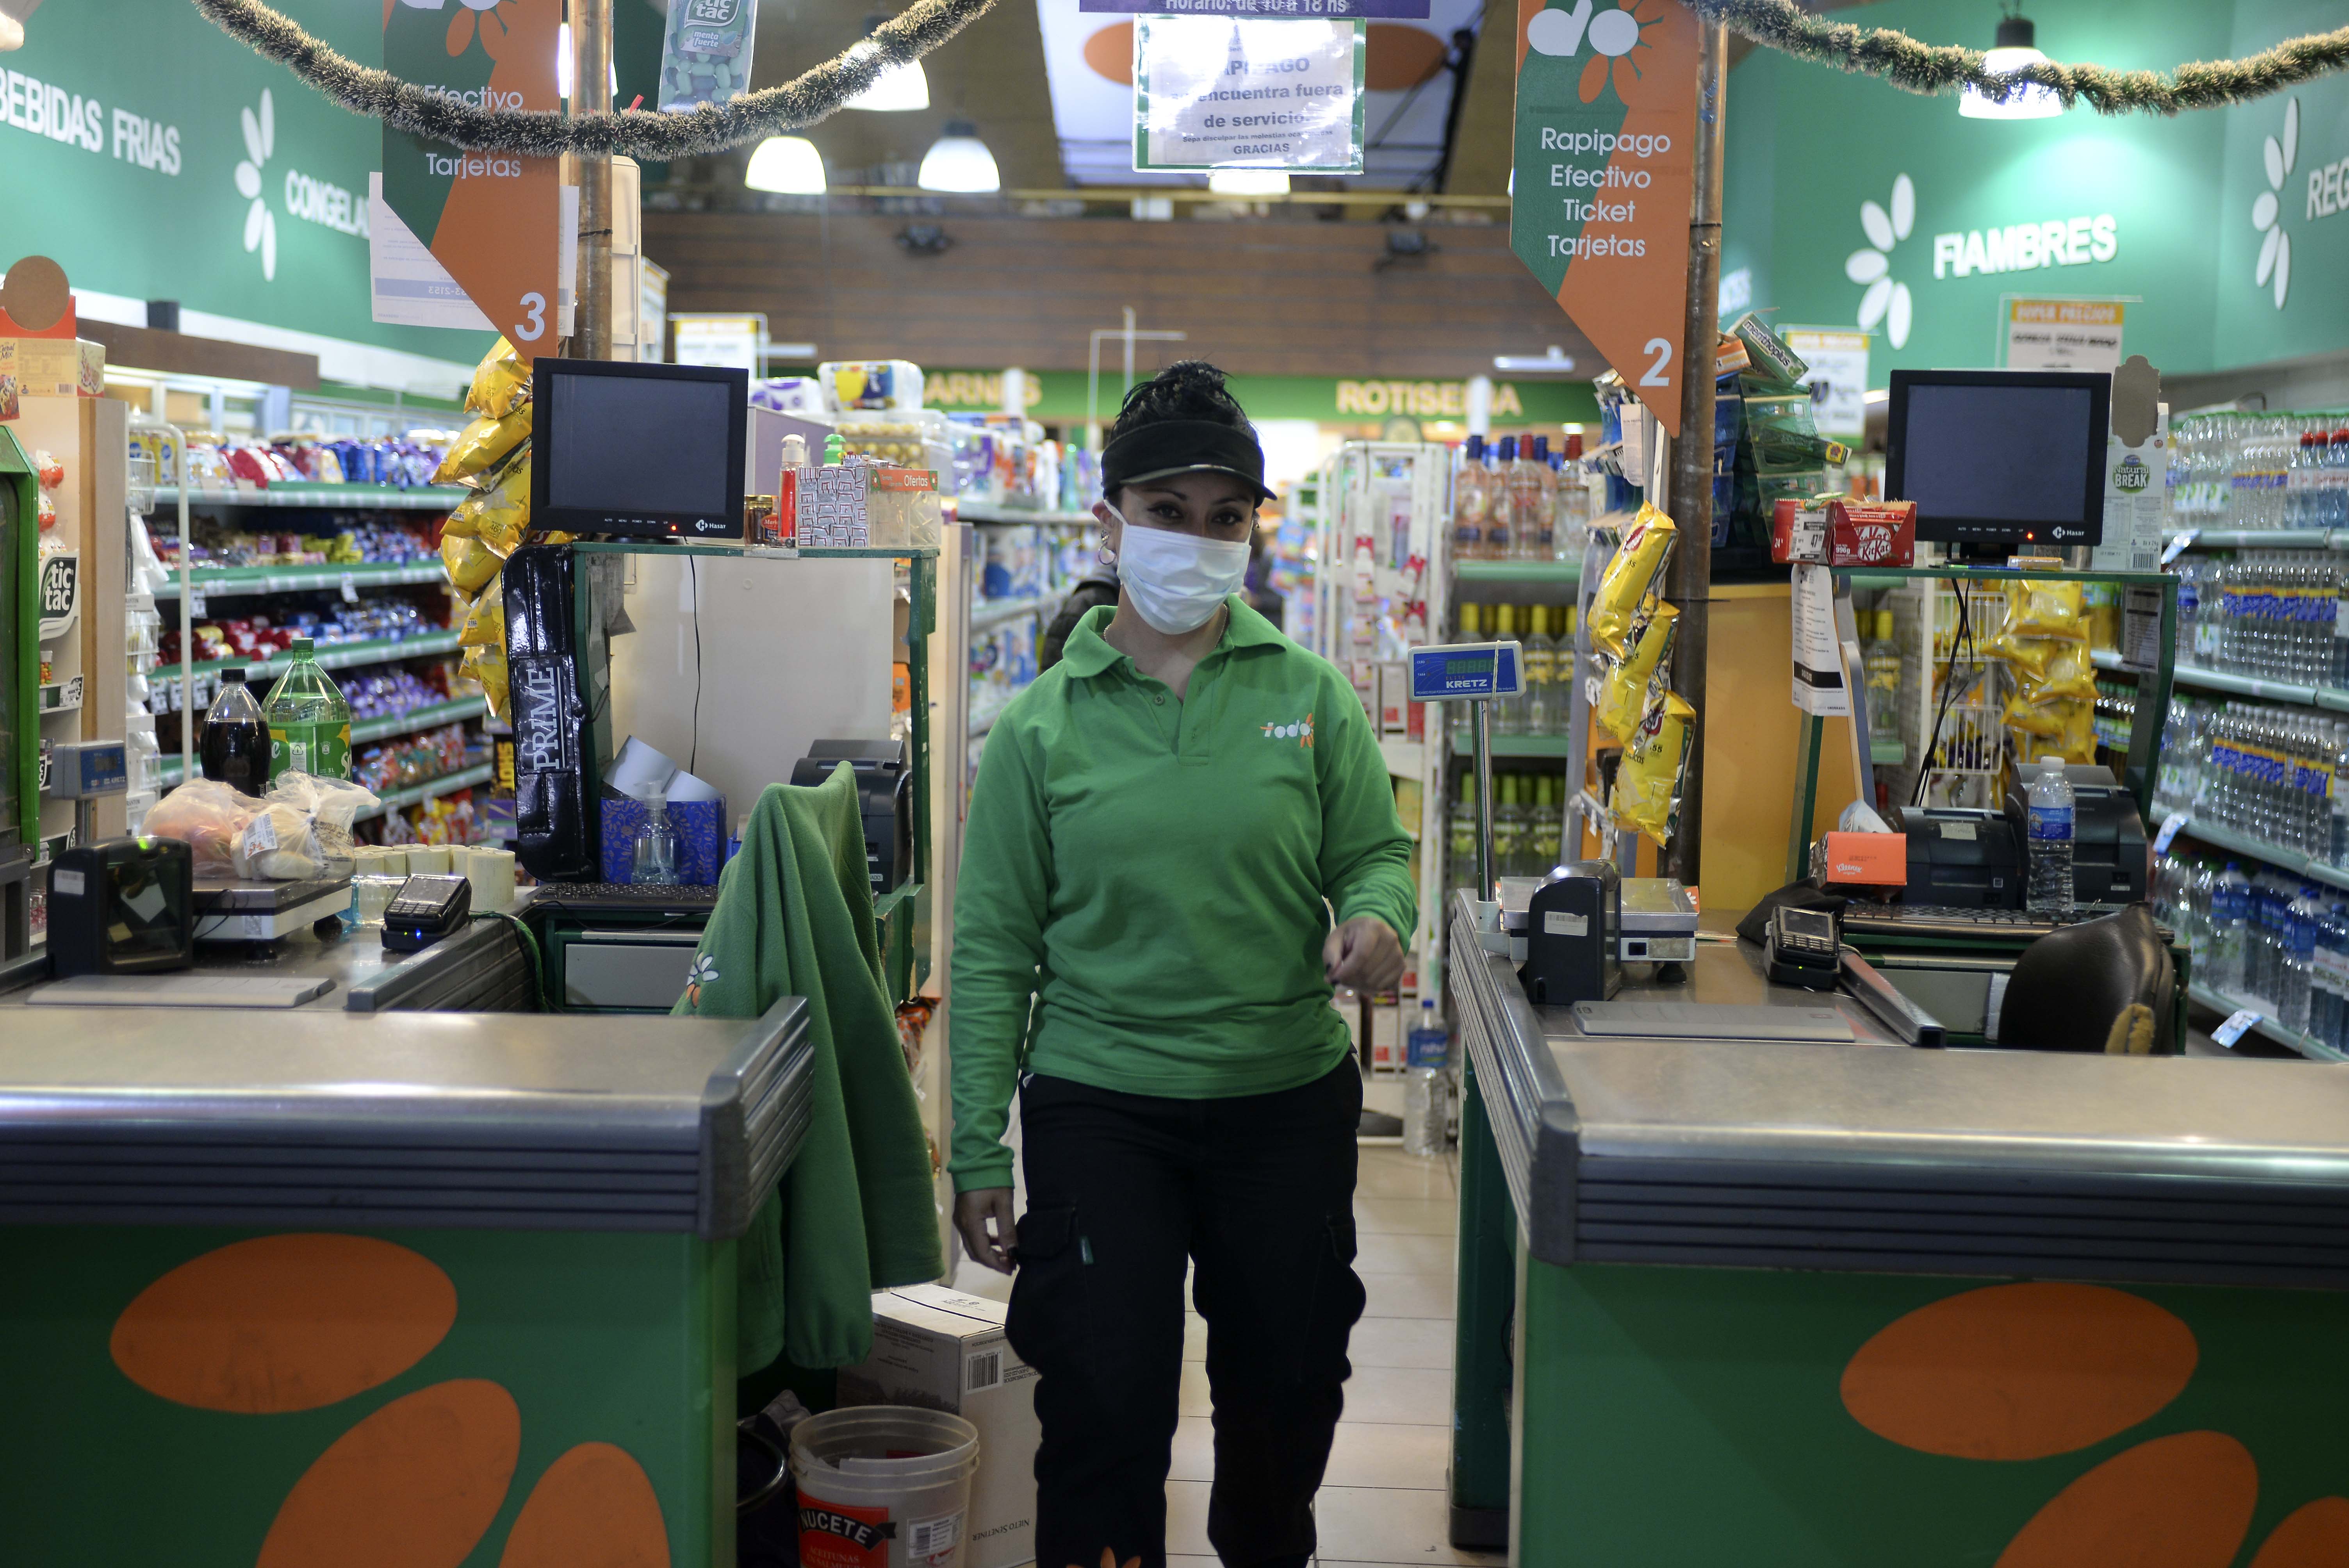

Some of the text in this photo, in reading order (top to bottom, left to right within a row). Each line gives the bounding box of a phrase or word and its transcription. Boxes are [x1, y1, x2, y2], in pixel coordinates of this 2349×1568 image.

[696, 3, 729, 20] tac
[693, 38, 719, 46] fuerte
[694, 31, 719, 39] menta
[1296, 84, 1344, 98] fuera
[0, 66, 182, 177] BEBIDAS FRIAS
[1204, 116, 1226, 128] de
[1203, 134, 1236, 143] disculpar
[1233, 143, 1290, 154] GRACIAS
[1541, 127, 1671, 157] Rapipago
[426, 153, 521, 178] Tarjetas
[1551, 164, 1651, 189] Efectivo
[1563, 198, 1635, 223] Ticket
[1547, 234, 1646, 260] Tarjetas
[1934, 214, 2117, 280] FIAMBRES
[515, 292, 546, 340] 3
[1742, 319, 1791, 367] menthoplus
[0, 351, 13, 360] Mix
[1640, 337, 1673, 387] 2
[904, 474, 929, 487] Ofertas
[2113, 465, 2149, 474] Natural
[2115, 474, 2148, 488] BREAK
[51, 561, 72, 589] tic
[45, 586, 71, 611] tac
[1446, 679, 1487, 689] KRETZ
[528, 666, 560, 772] PRIME
[1259, 719, 1311, 738] todo
[1836, 863, 1862, 873] Kleenex
[800, 1509, 872, 1545] NUCETE
[972, 1518, 1030, 1541] NIETO SENETINER
